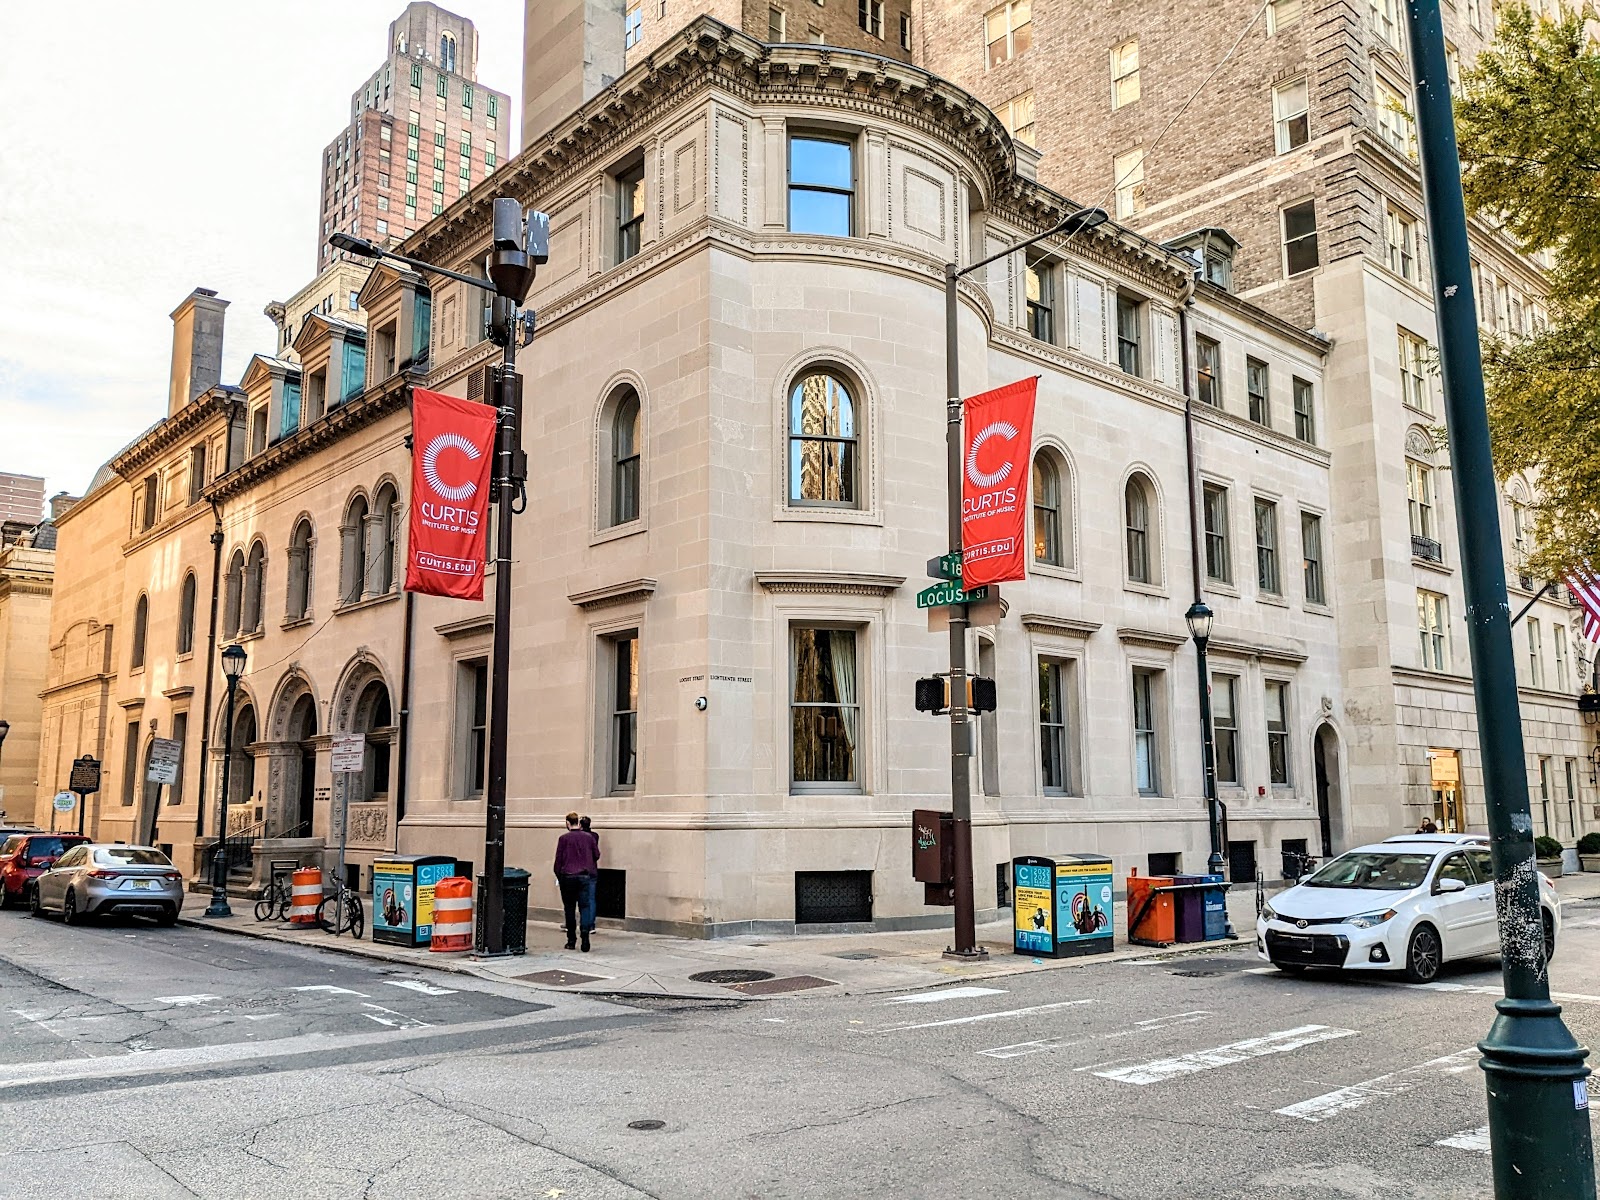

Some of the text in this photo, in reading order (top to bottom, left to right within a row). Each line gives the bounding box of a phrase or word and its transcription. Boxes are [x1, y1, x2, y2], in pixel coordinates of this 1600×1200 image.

[963, 487, 1016, 514] CURTIS
[421, 502, 479, 526] CURTIS
[963, 512, 987, 522] NSTITUTE
[996, 506, 1016, 515] MUSIC
[421, 519, 450, 531] INTITUTE
[460, 527, 477, 535] MUSIC
[966, 543, 1010, 559] URTIS.EDU
[976, 588, 985, 599] ST
